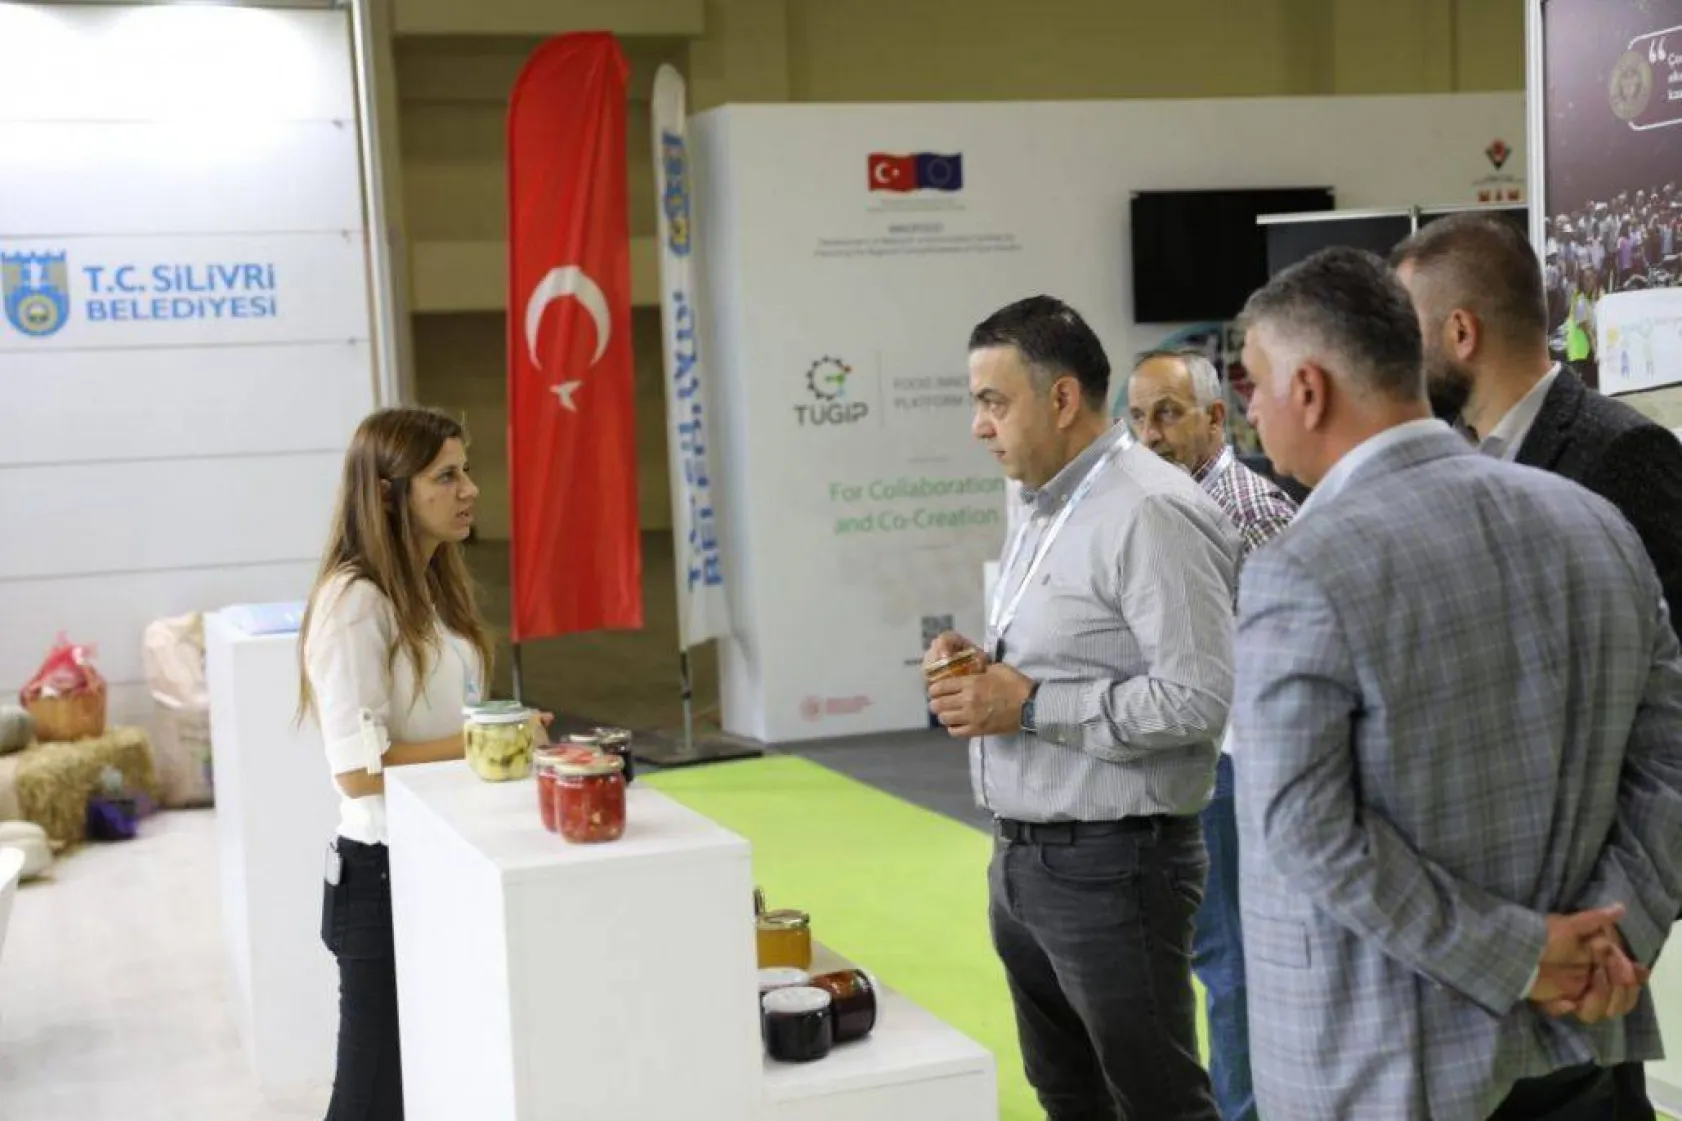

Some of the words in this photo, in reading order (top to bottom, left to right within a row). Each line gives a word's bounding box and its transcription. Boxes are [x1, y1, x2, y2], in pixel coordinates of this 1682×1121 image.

[83, 265, 146, 292] T.C.
[829, 481, 863, 500] For
[869, 477, 1004, 501] Collaboration
[835, 513, 873, 532] and
[878, 506, 1000, 531] Co-Creation
